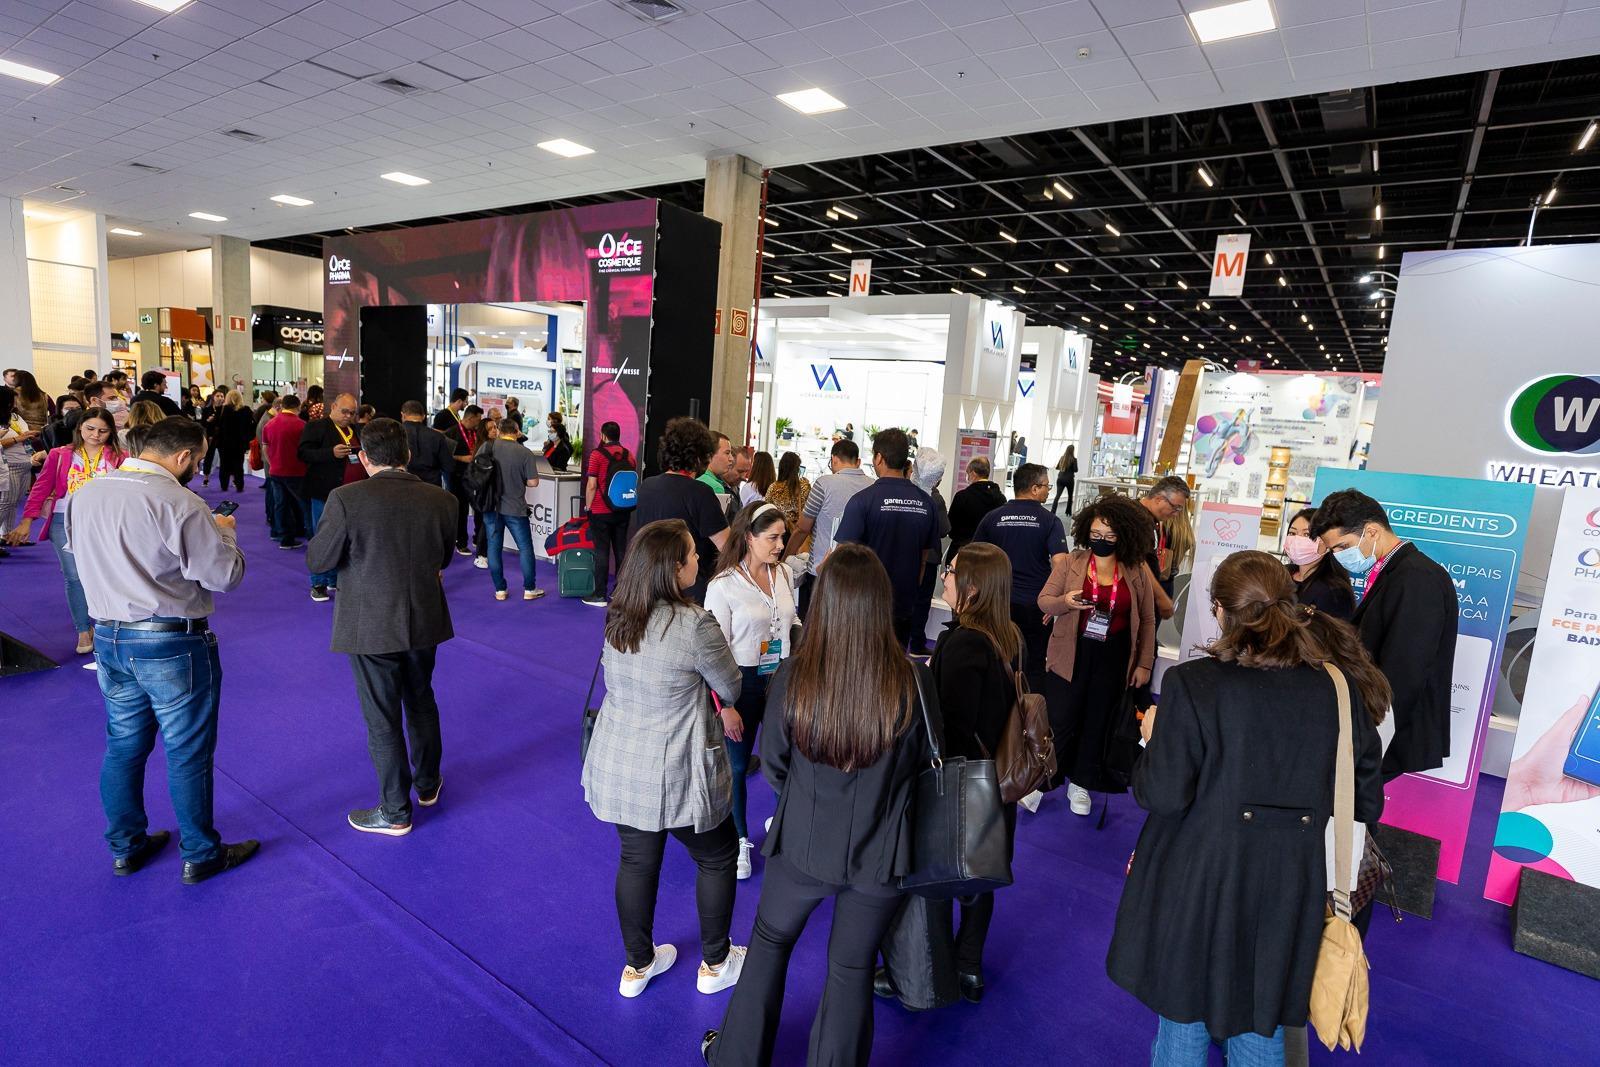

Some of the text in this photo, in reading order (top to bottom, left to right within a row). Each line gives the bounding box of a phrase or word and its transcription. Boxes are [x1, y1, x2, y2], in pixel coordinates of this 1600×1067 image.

[616, 239, 642, 256] FCE
[598, 257, 641, 267] COSMETIQUE
[1215, 252, 1245, 277] M
[853, 273, 867, 292] N
[592, 366, 618, 374] NÜRNBERG
[487, 377, 542, 391] REVERSA
[1554, 396, 1600, 433] W
[1217, 542, 1249, 550] TOGETHER
[1477, 597, 1488, 607] A
[1564, 608, 1598, 620] Para
[1552, 618, 1581, 630] FCE
